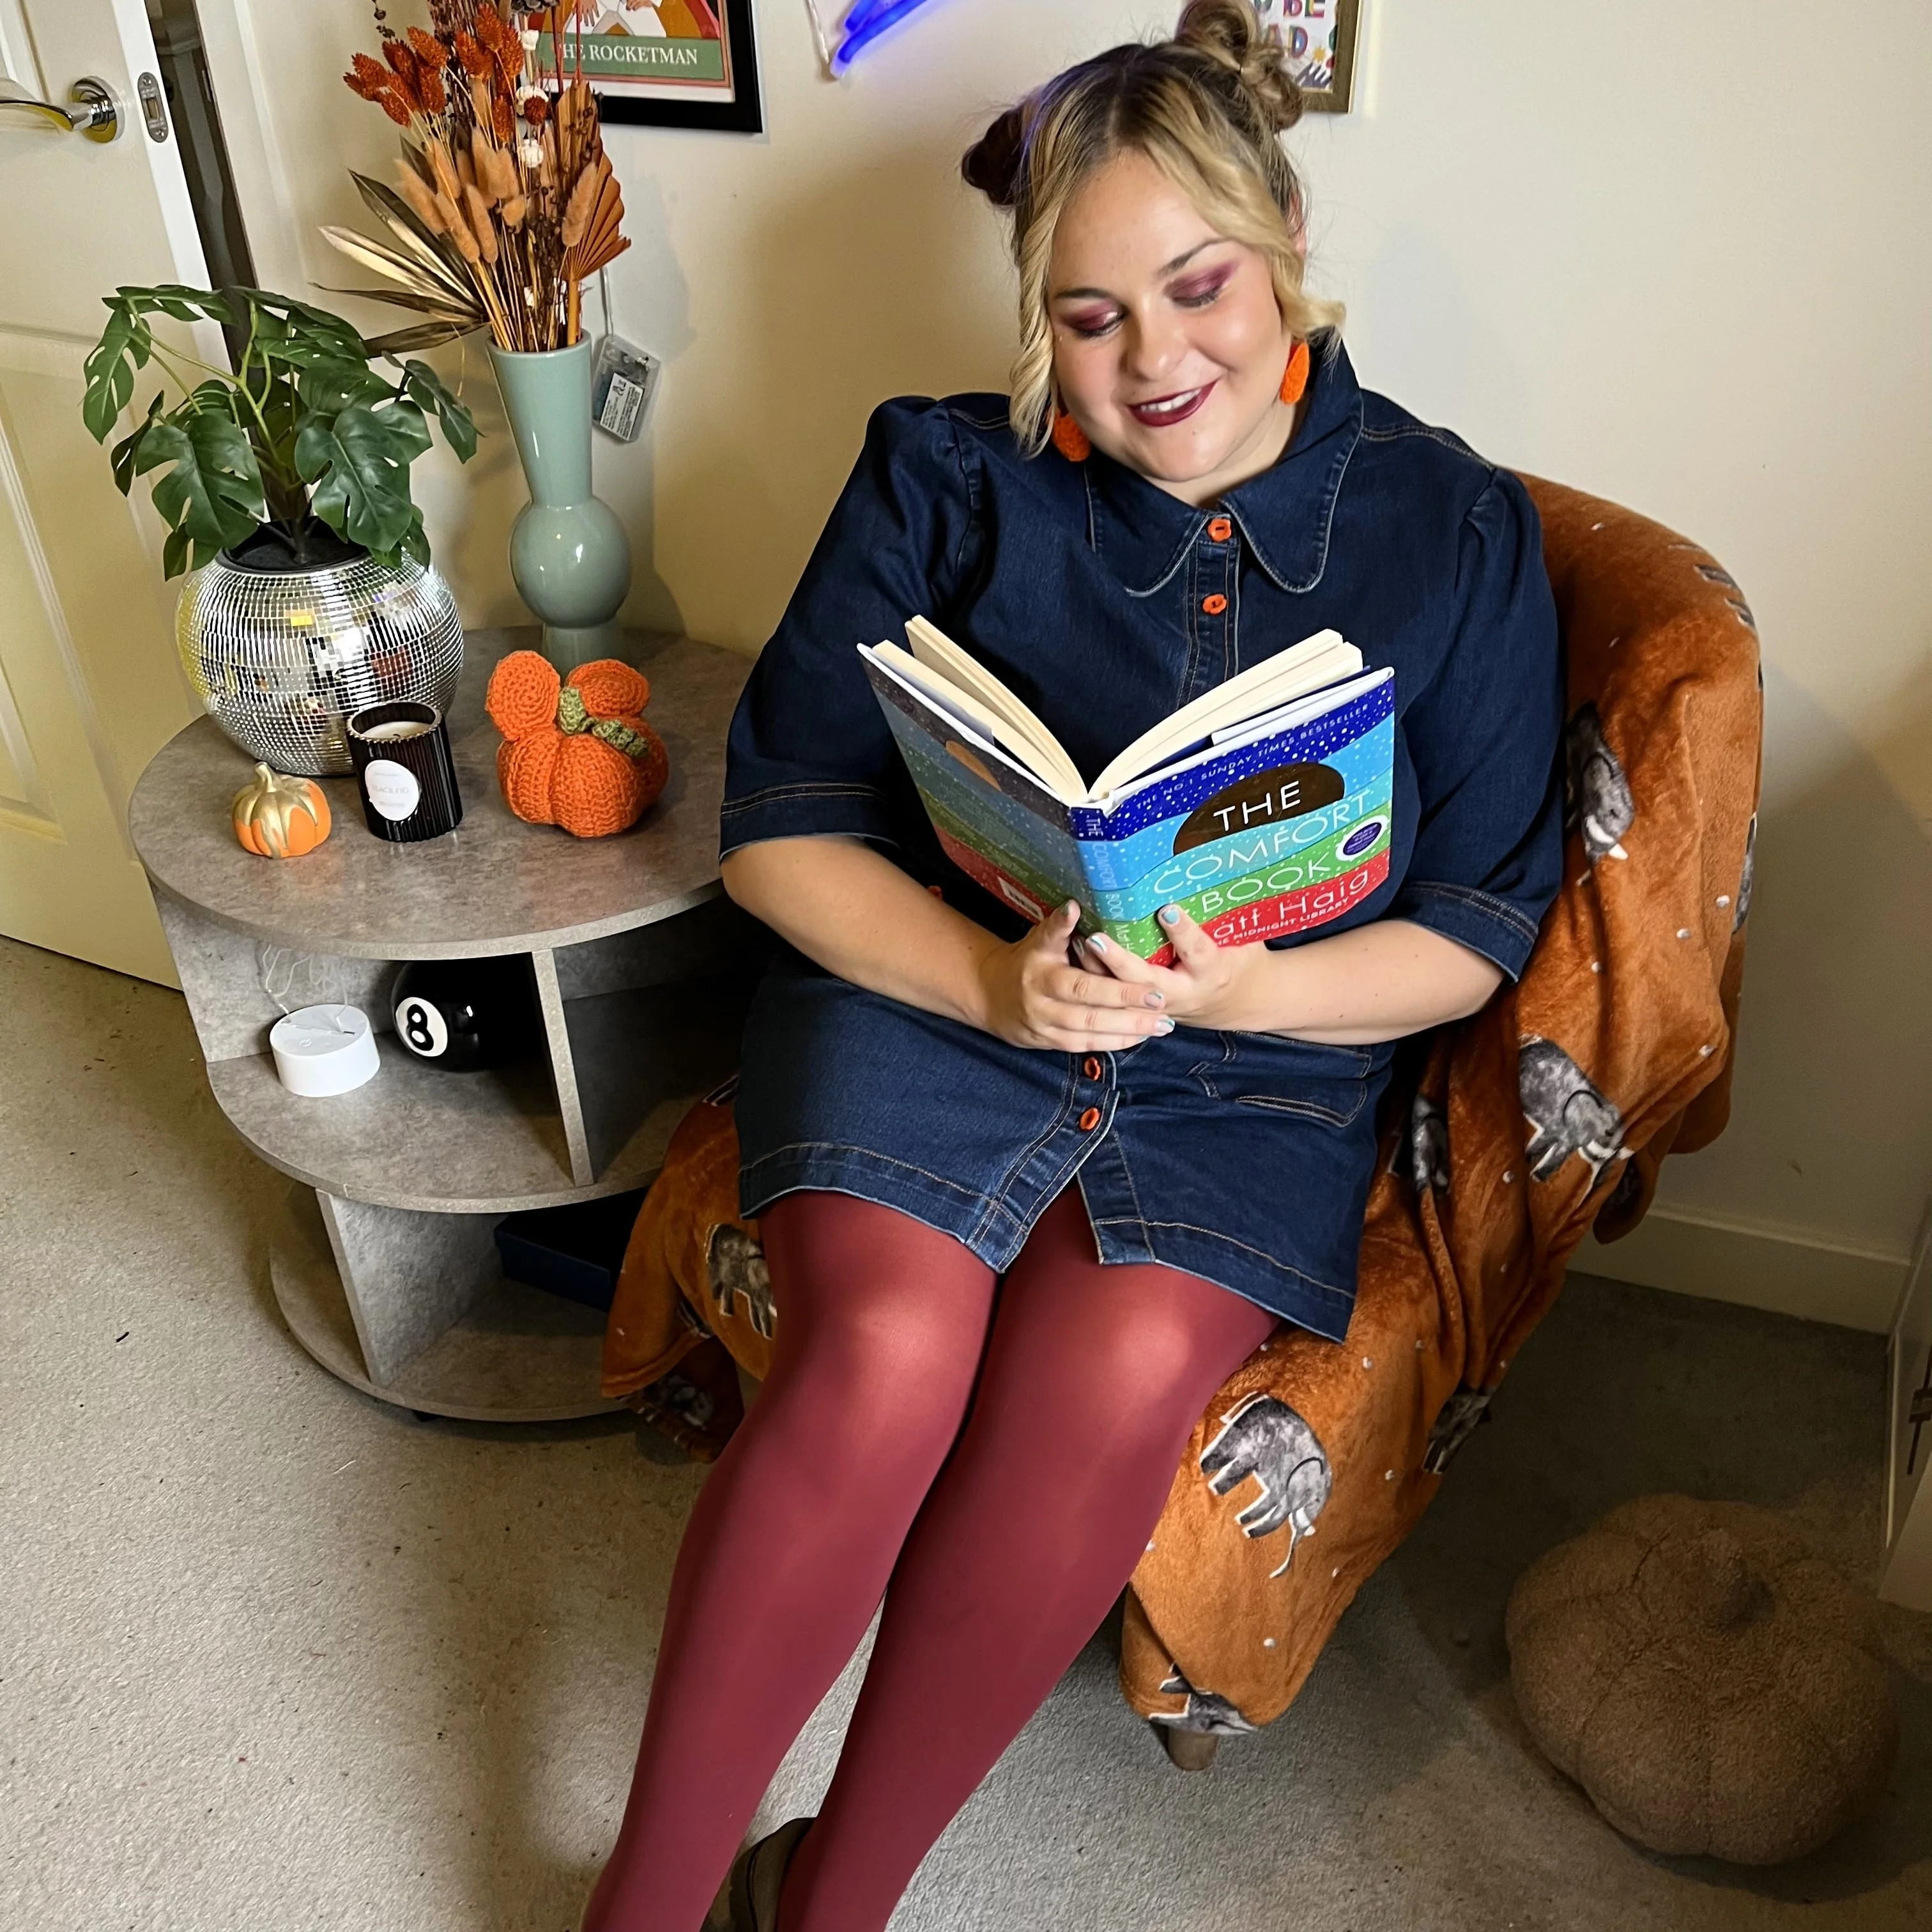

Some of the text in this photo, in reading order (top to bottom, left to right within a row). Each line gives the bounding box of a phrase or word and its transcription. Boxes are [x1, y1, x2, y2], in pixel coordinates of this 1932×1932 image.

[558, 43, 698, 65] HE ROCKETMAN
[1136, 794, 1158, 809] THE
[1200, 755, 1252, 781] SUNDAY
[1258, 737, 1295, 757] TIMES
[1300, 703, 1368, 740] BESTSELLER
[1085, 817, 1104, 836] THE
[1213, 780, 1301, 831] THE
[1154, 789, 1373, 894] COMFORT
[1092, 843, 1118, 889] COMFORT
[1201, 852, 1331, 914] BOOK
[1105, 893, 1125, 920] BOOK
[1233, 896, 1349, 940] MIDNIGHT LIBRARY
[1280, 869, 1368, 920] Haig
[406, 1004, 434, 1051] 8
